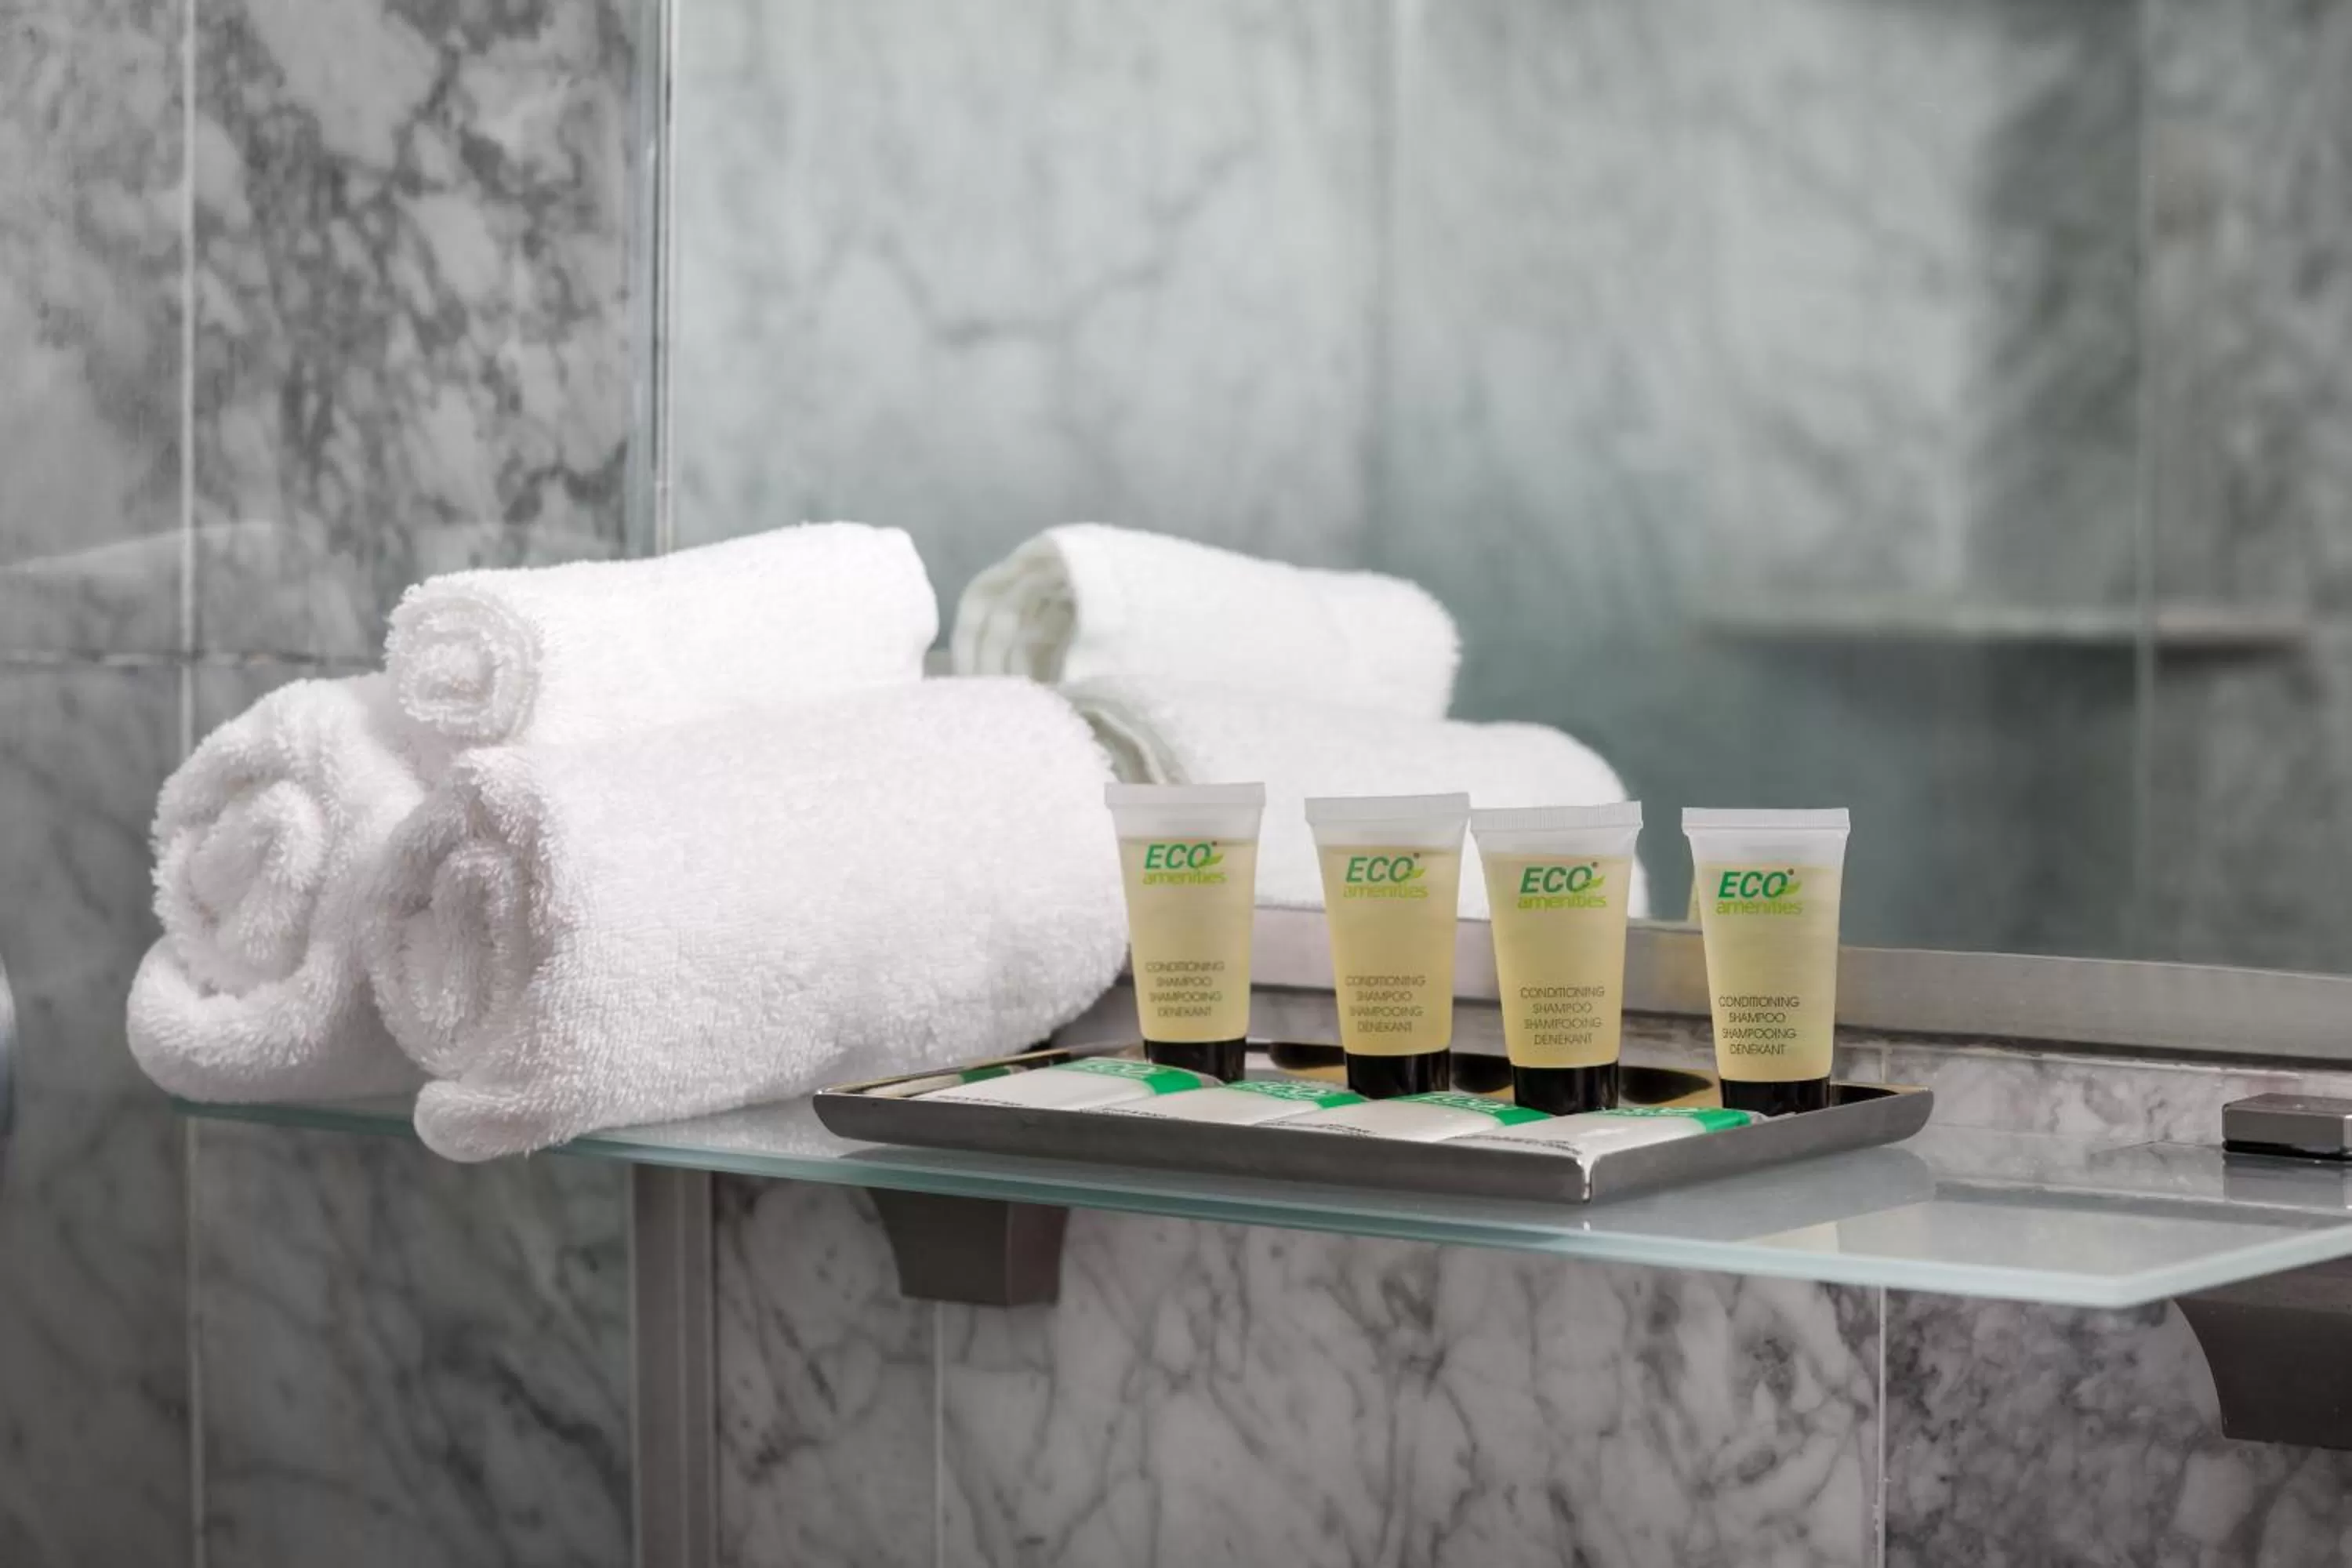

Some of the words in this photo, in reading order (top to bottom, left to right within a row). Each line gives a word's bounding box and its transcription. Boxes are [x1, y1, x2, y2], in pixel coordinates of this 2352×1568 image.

[1144, 843, 1211, 869] ECO
[1142, 866, 1228, 885] amenities
[1345, 856, 1414, 883] ECO
[1520, 866, 1592, 894] ECO
[1718, 870, 1788, 898] ECO
[1343, 880, 1428, 898] amenities
[1518, 891, 1607, 909] amenities
[1716, 898, 1802, 915] amenities
[1145, 960, 1225, 973] CONDITIONING
[1156, 976, 1213, 988] SHAMPOO
[1345, 975, 1426, 987] CONDITIONING
[1356, 990, 1414, 1003] SHAMPOO
[1519, 985, 1605, 998] CONDITIONING
[1532, 1002, 1593, 1014] SHAMPOO
[1718, 996, 1800, 1008] CONDITIONING
[1523, 1017, 1602, 1029] SHAMPOOING
[1728, 1011, 1787, 1024] SHAMPOO
[1721, 1027, 1797, 1040] SHAMPOOING
